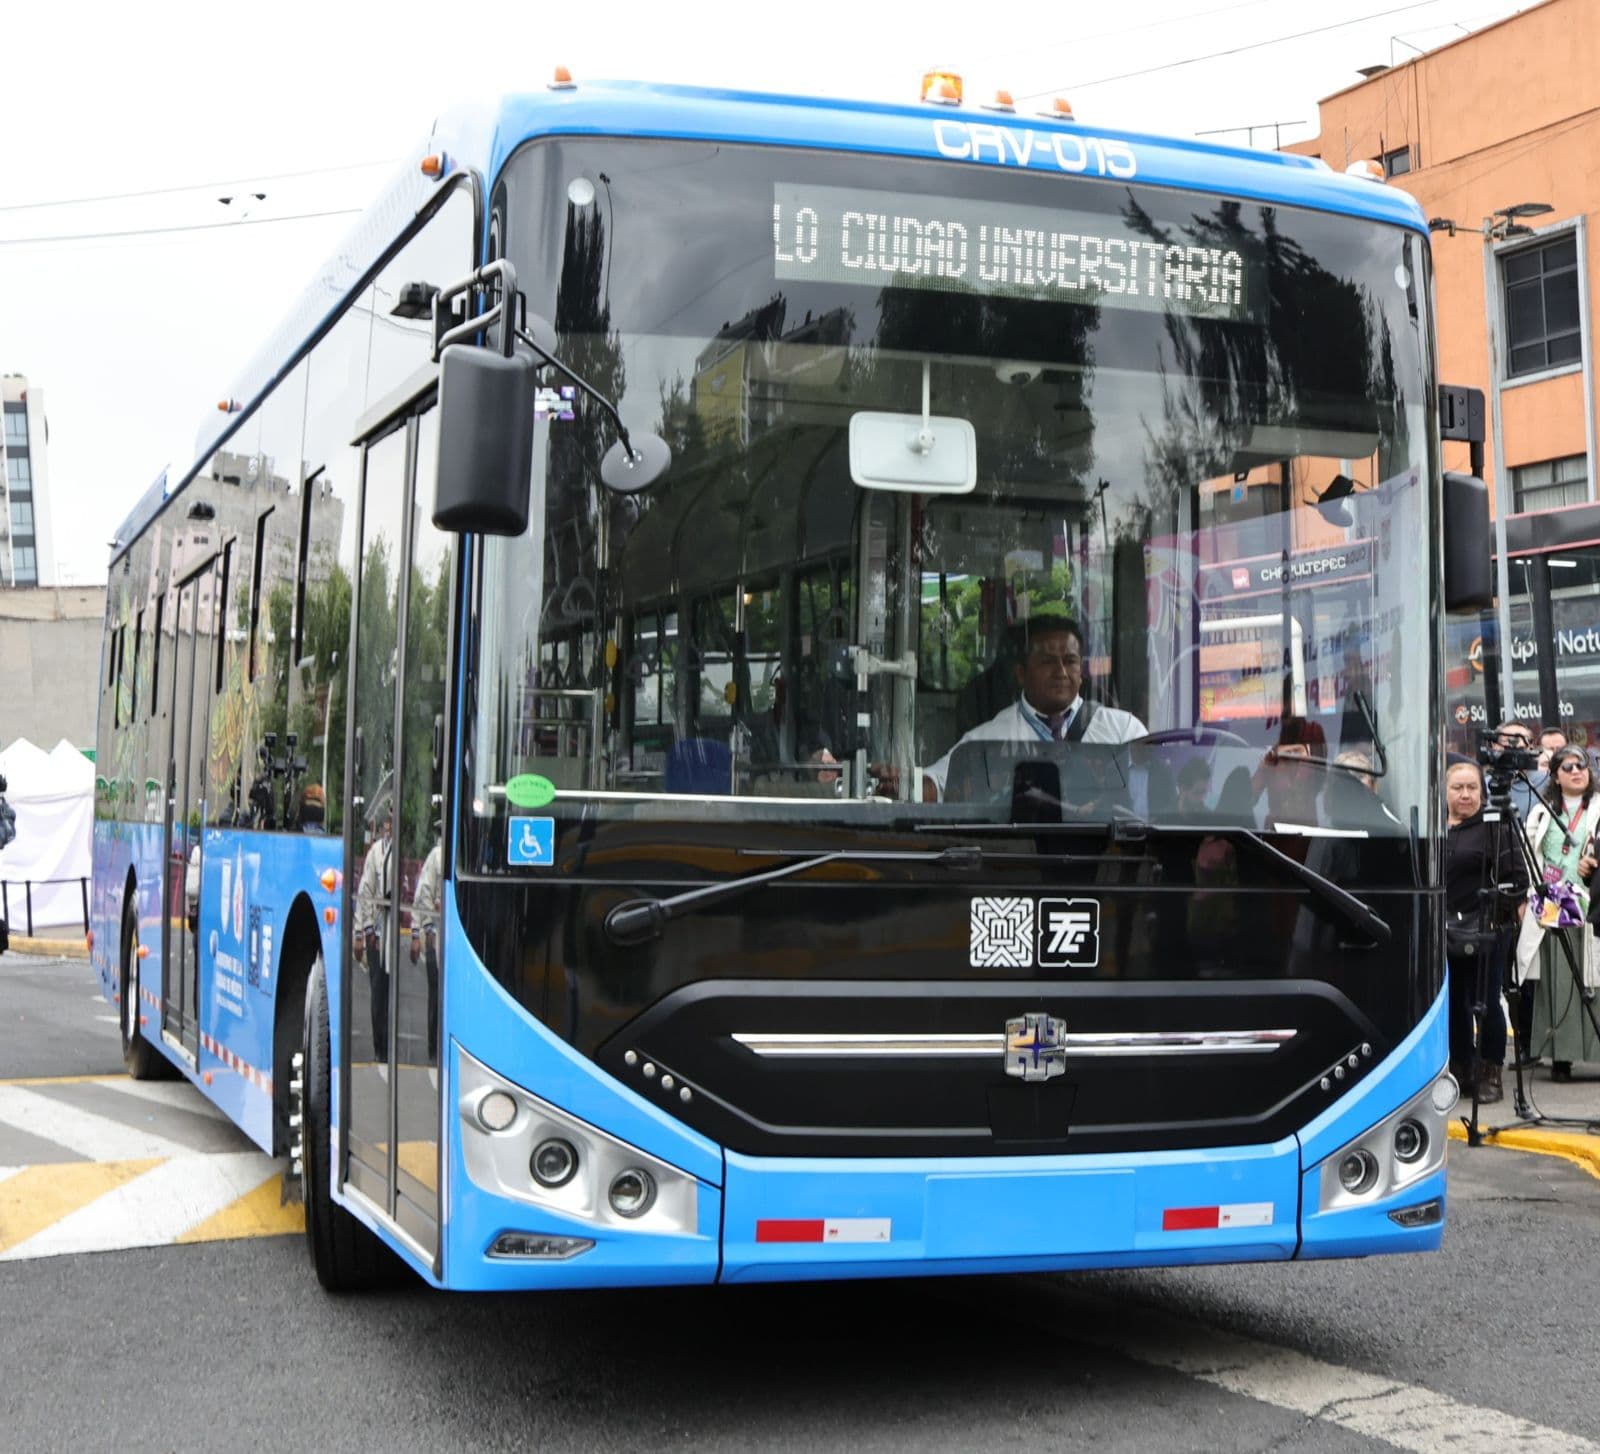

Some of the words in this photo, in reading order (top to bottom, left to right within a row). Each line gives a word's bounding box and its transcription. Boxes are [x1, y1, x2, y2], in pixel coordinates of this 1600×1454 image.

[933, 119, 1137, 179] CRV-015
[841, 211, 968, 278] CIUDAD
[979, 225, 1243, 305] UNIVERSITARIA
[1260, 556, 1346, 582] CHAULTEPEC
